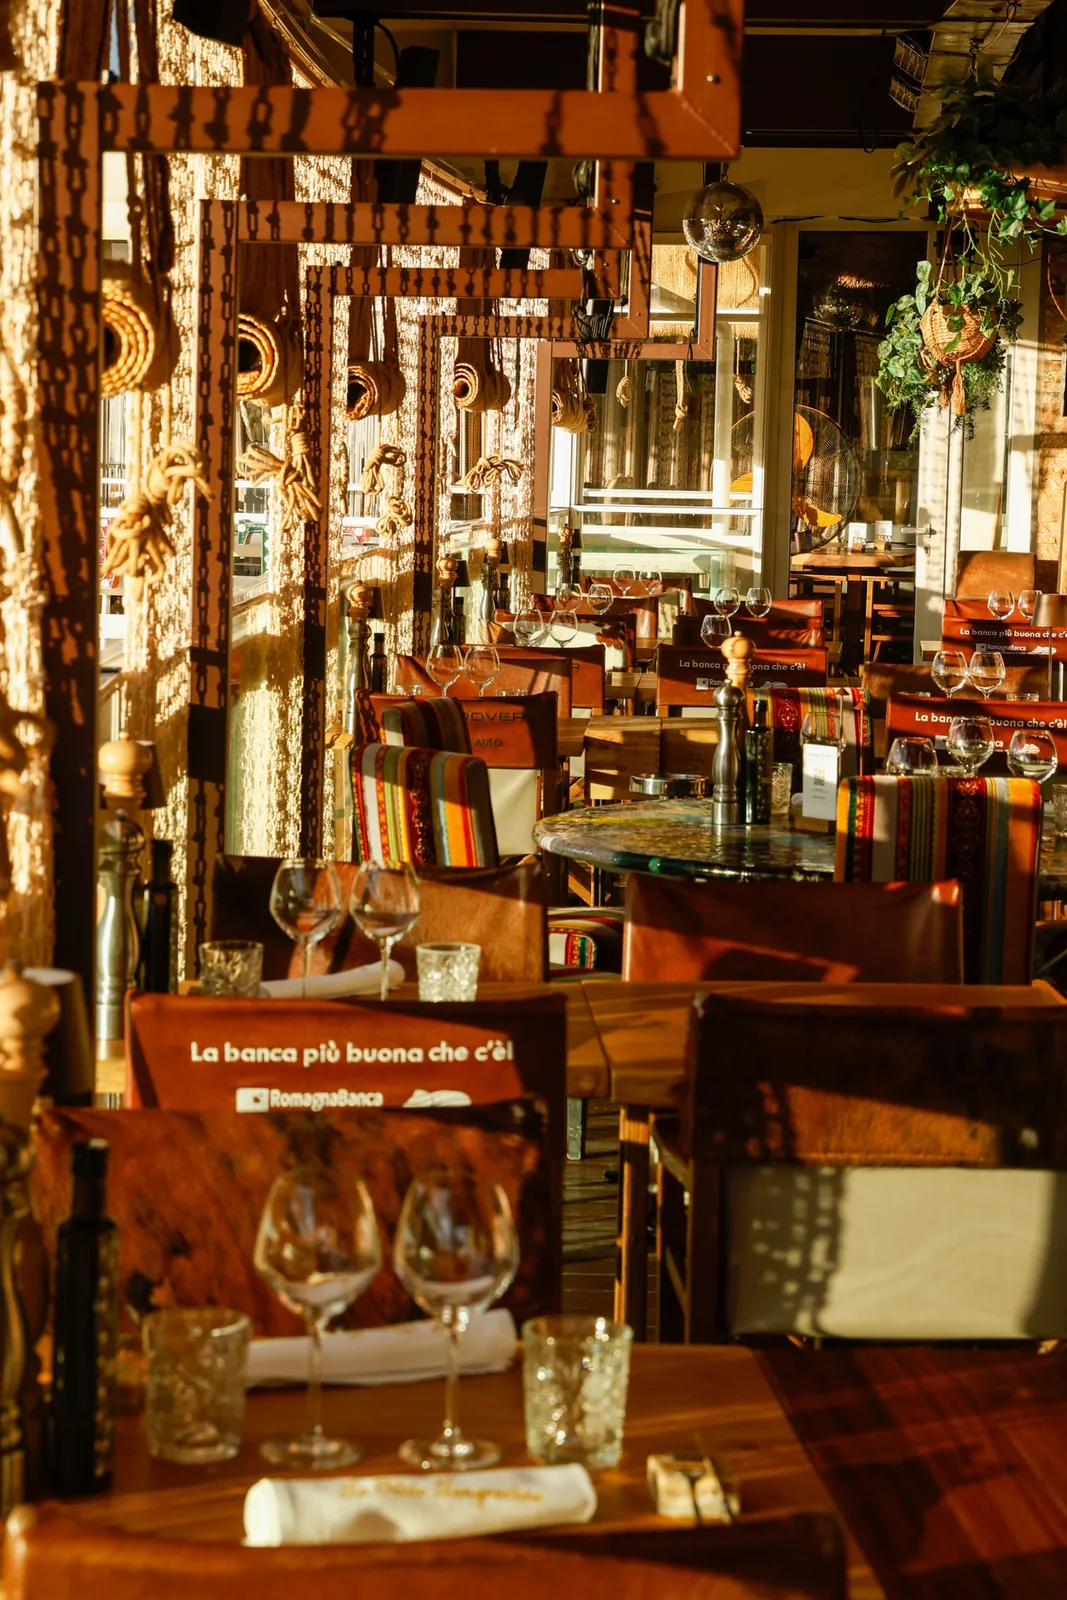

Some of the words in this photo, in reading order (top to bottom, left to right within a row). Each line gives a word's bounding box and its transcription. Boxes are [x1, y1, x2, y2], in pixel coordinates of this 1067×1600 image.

[972, 629, 997, 637] banca
[1014, 630, 1041, 638] buona
[679, 659, 690, 668] La
[692, 660, 721, 669] banca
[771, 662, 788, 671] che
[466, 711, 525, 722] OVER
[915, 712, 928, 722] La
[989, 716, 1025, 728] buona
[1027, 718, 1046, 728] che
[475, 738, 502, 748] AUTO
[190, 1041, 219, 1063] La
[224, 1041, 298, 1063] banca
[303, 1039, 341, 1068] più
[346, 1041, 424, 1064] buona
[428, 1040, 469, 1063] che
[270, 1088, 384, 1112] RomagnaBanca
